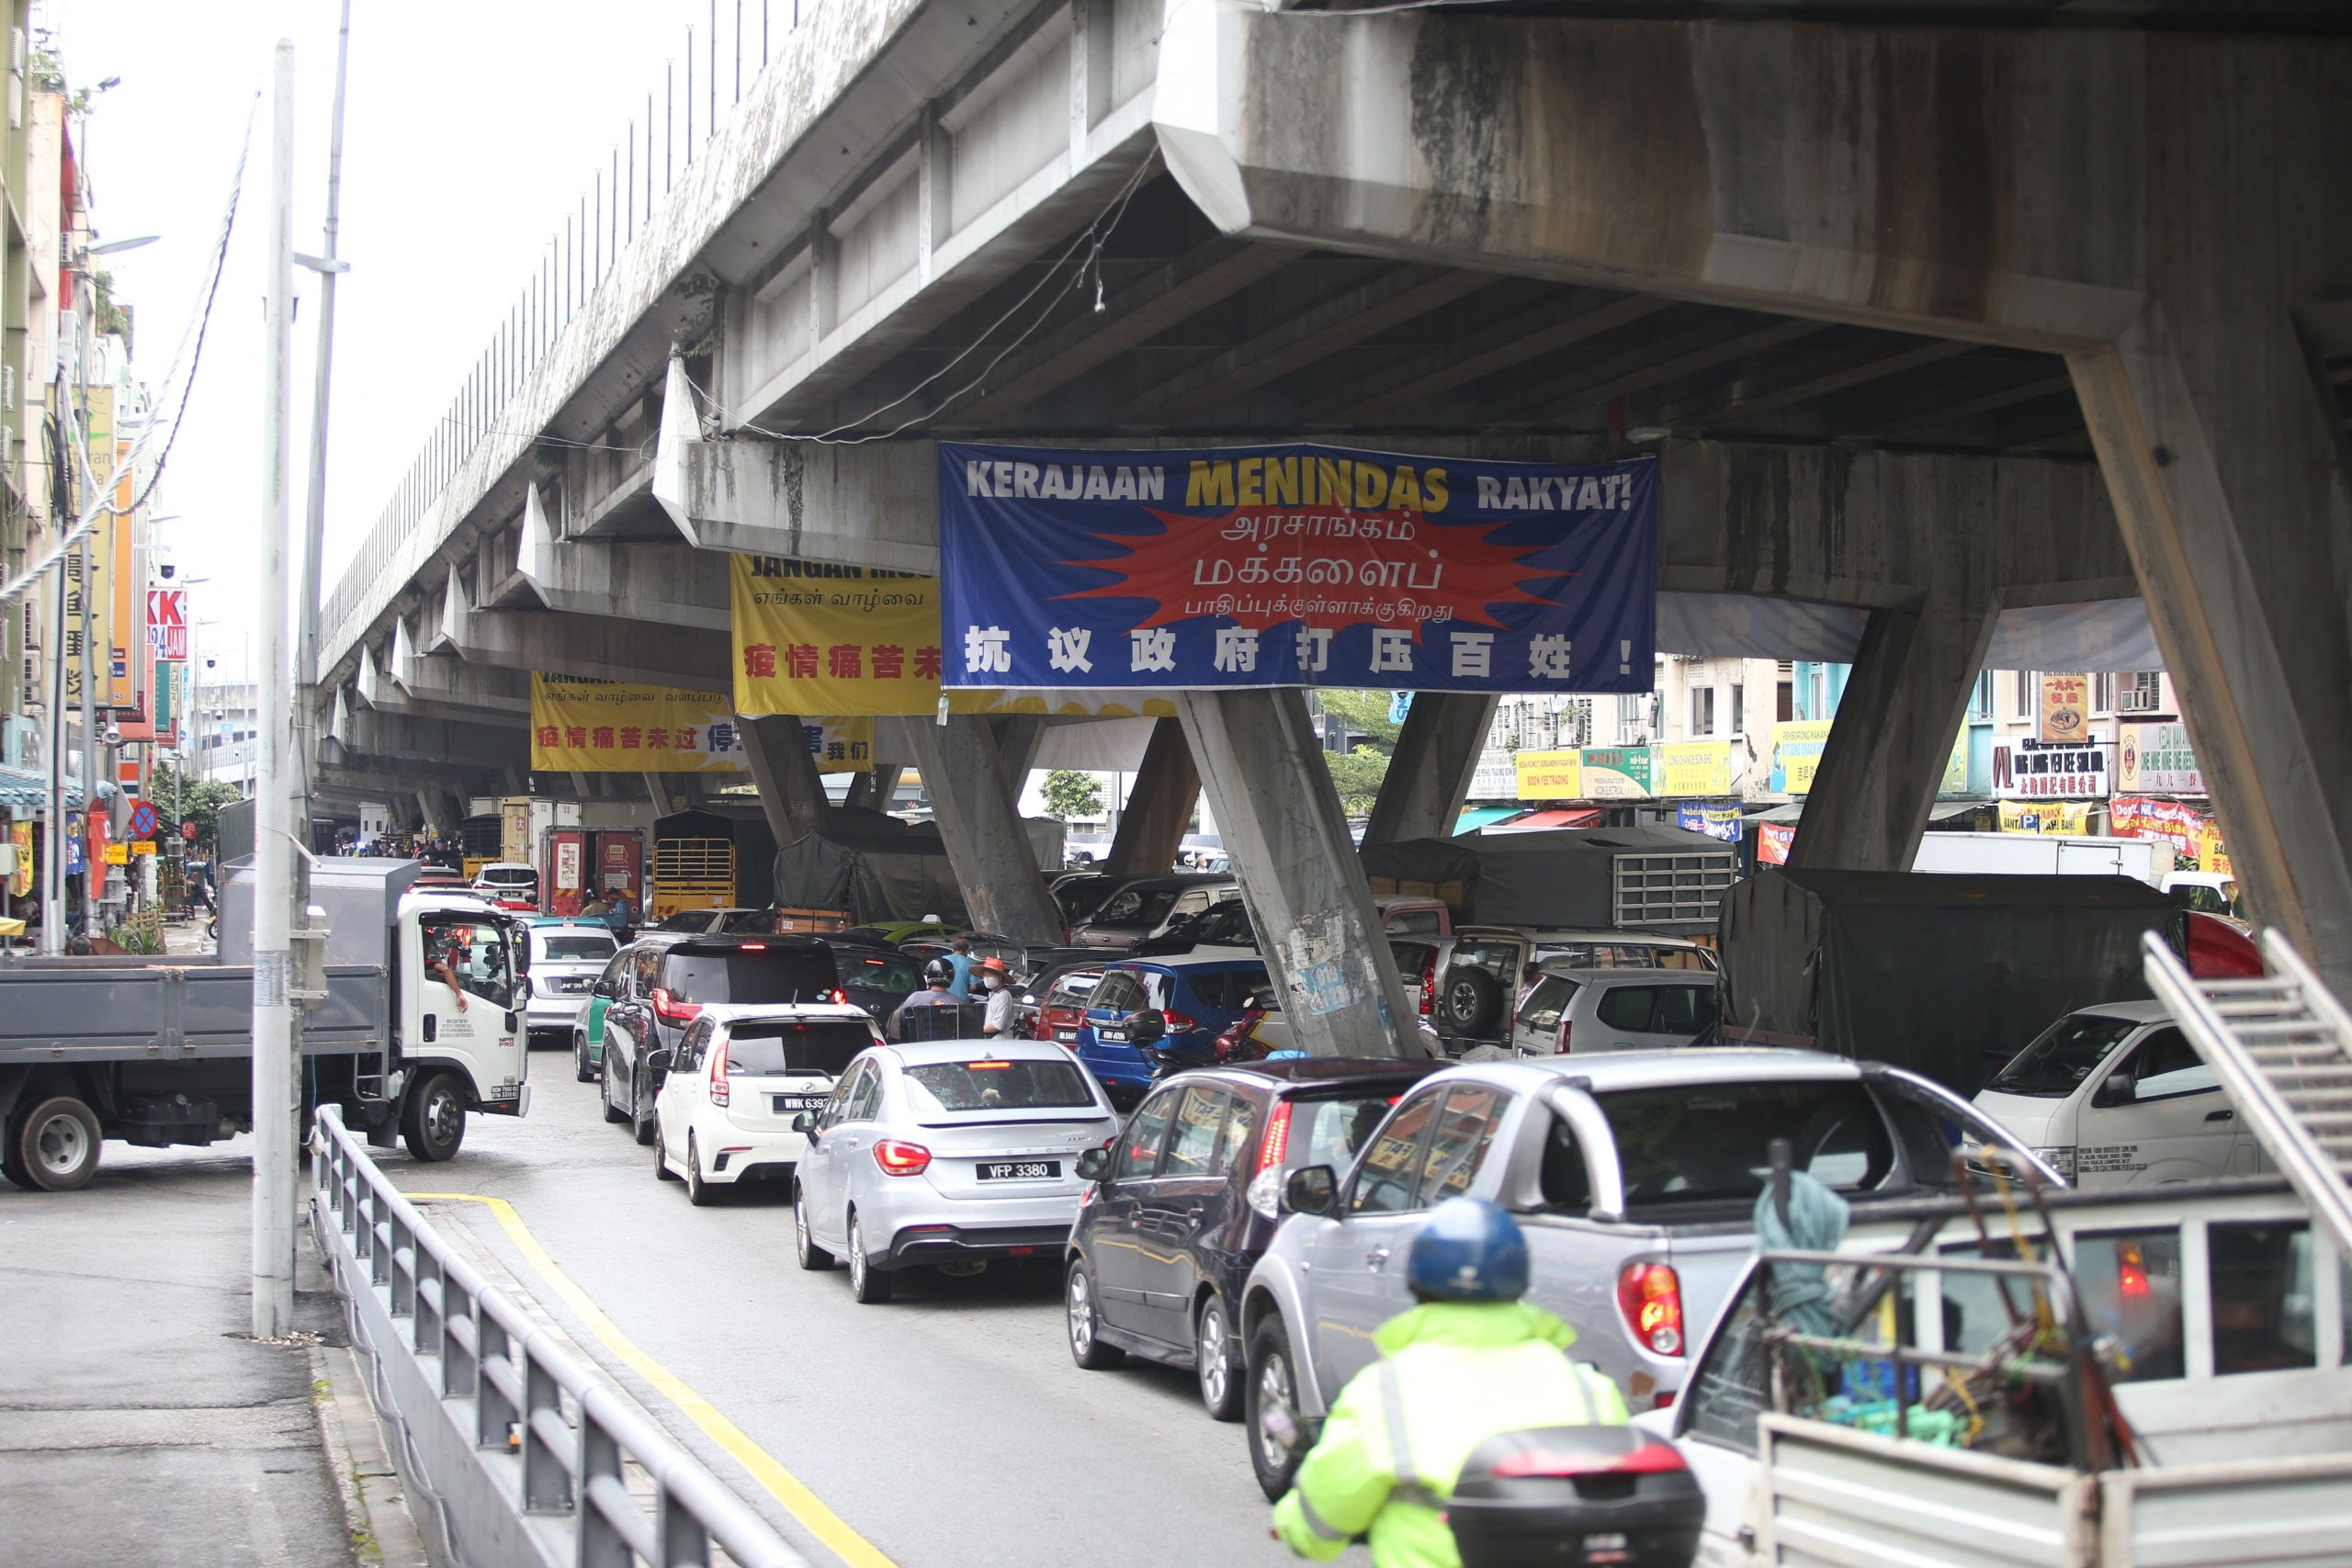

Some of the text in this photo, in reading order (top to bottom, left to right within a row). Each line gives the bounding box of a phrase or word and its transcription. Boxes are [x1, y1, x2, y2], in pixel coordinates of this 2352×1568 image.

[967, 456, 1633, 513] KERAJAAN MENINDAS RAKYAT!
[1220, 507, 1416, 542] அரசாங்கம்
[1193, 543, 1443, 590] மக்களைப்
[168, 627, 187, 659] JAM
[827, 741, 869, 761] 我们
[2024, 815, 2034, 828] P
[785, 1099, 804, 1109] WWK
[989, 1164, 1048, 1178] VFP 3380
